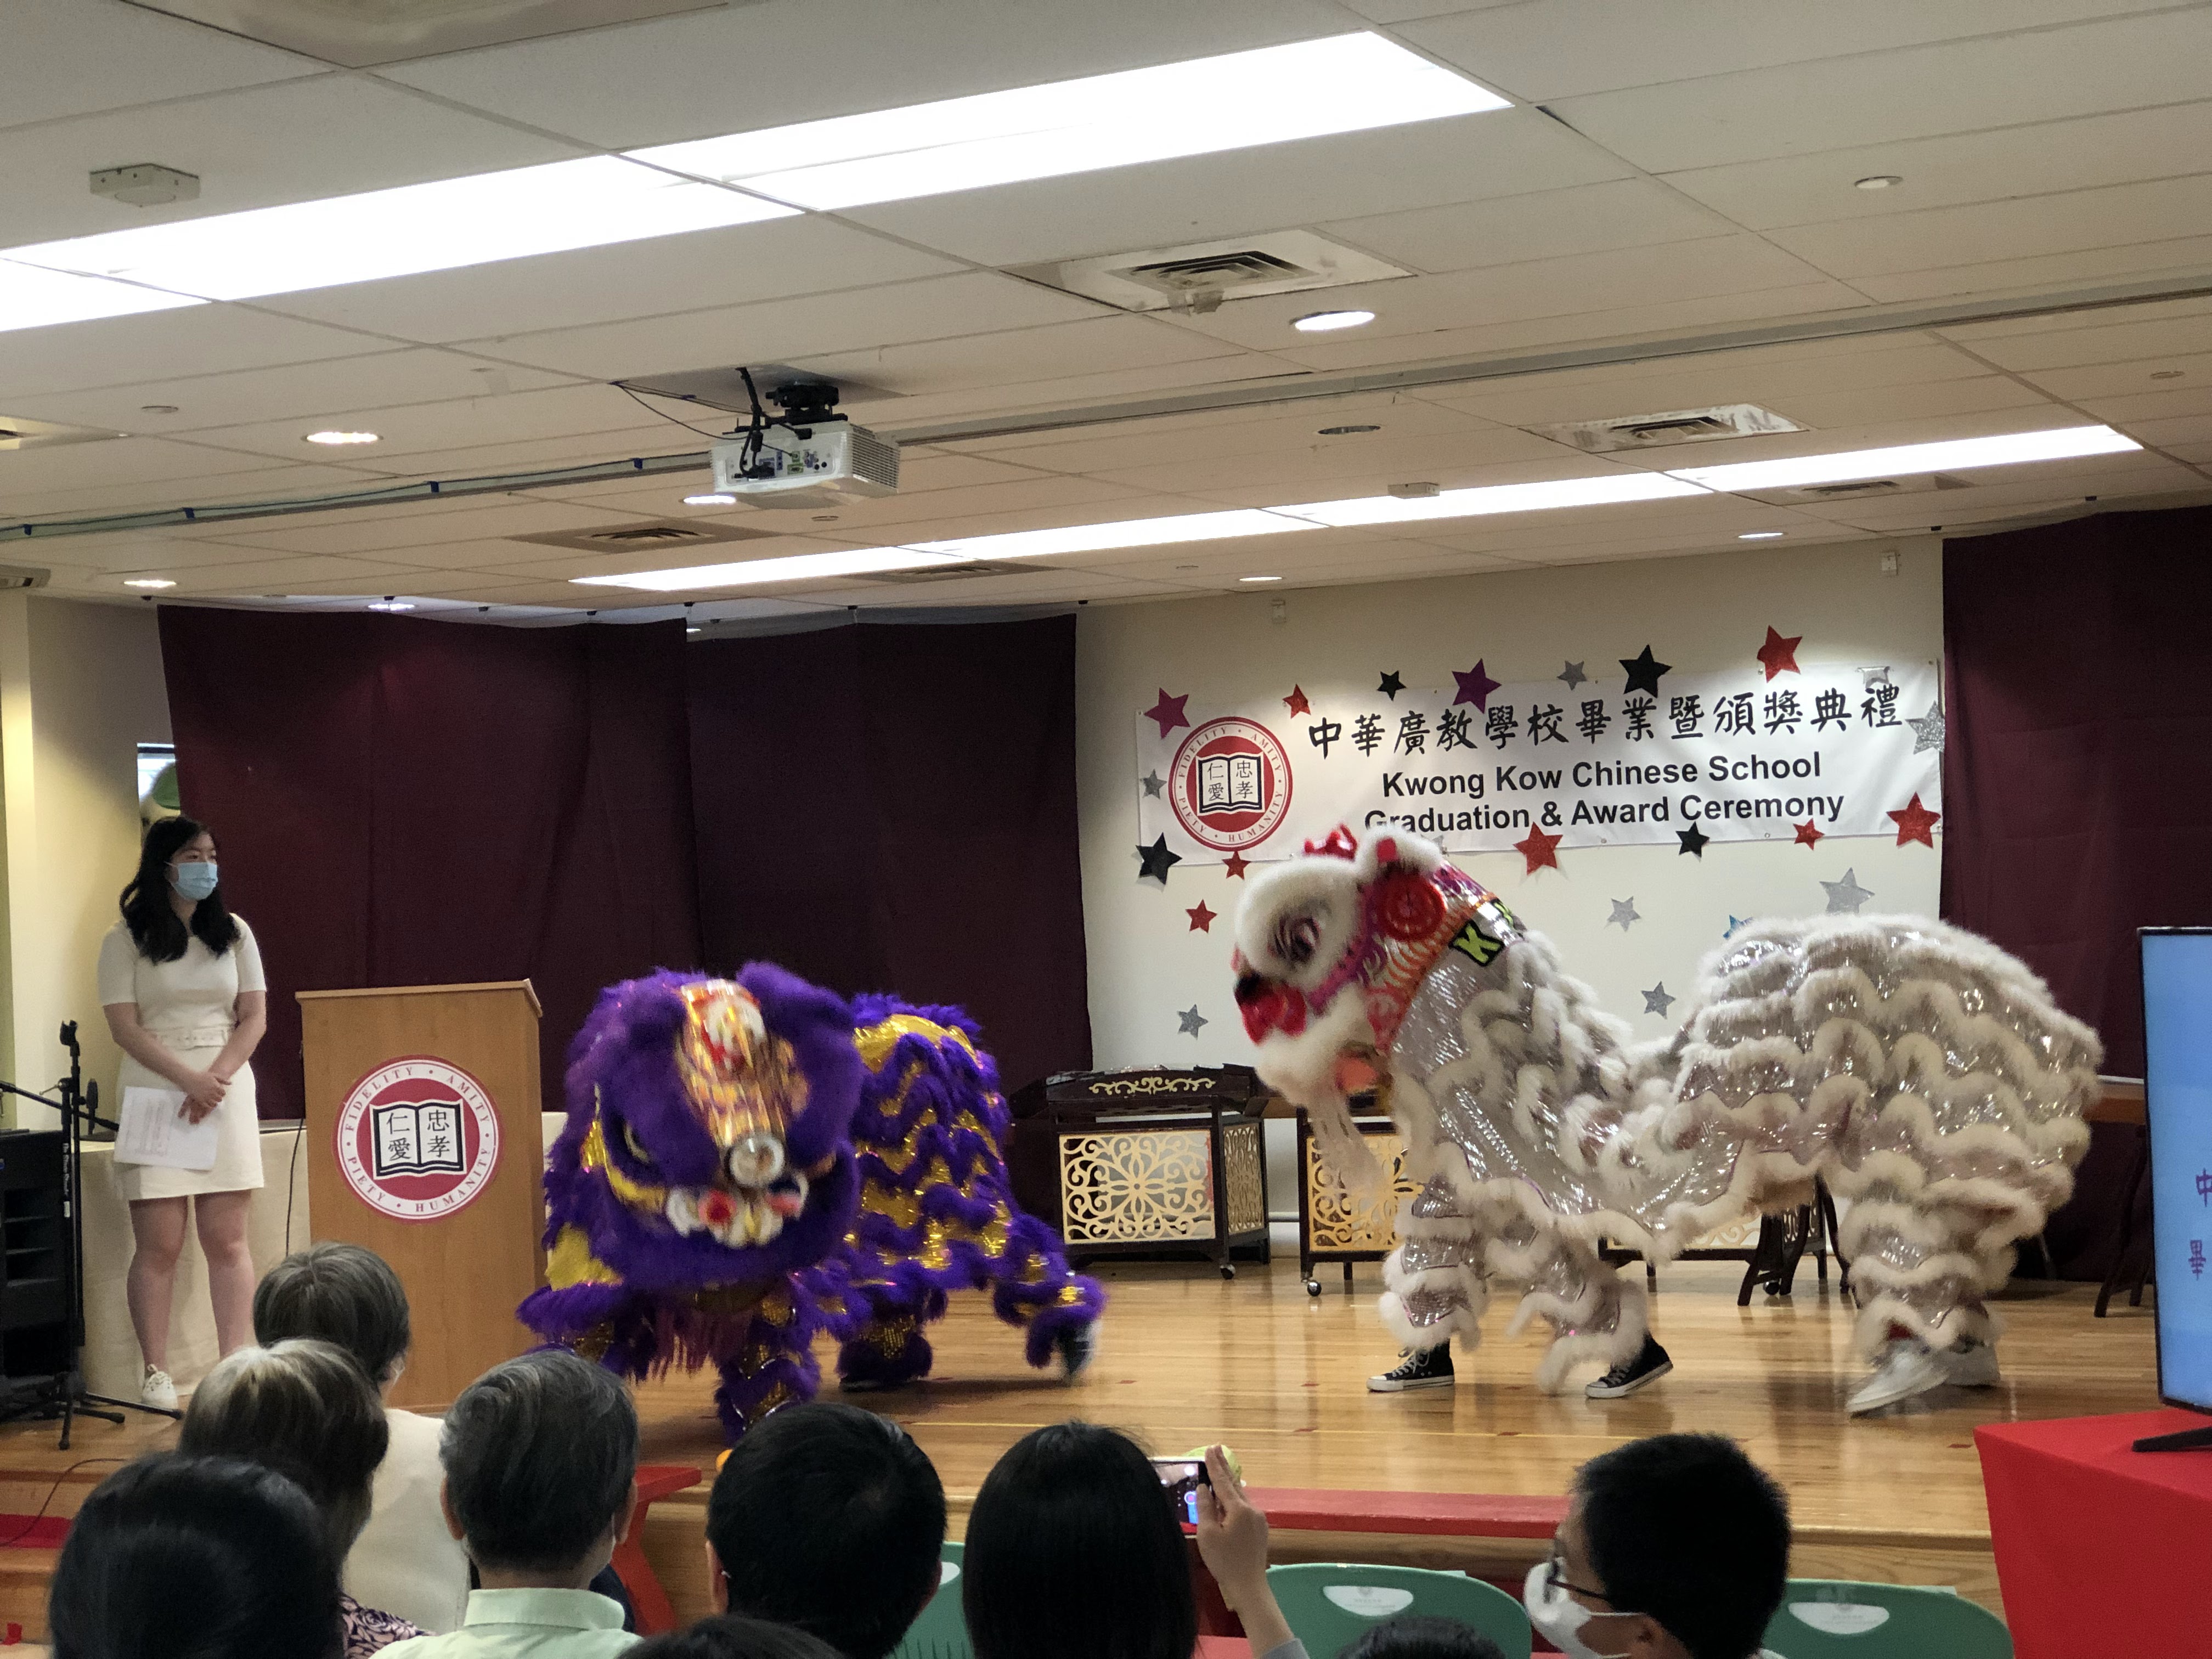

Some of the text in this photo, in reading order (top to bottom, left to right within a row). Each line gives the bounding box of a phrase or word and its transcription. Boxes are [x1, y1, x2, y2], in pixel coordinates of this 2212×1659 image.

[1308, 684, 1903, 760] 中華廣教學校畢業暨頒獎典禮
[1178, 727, 1228, 778] FIDELITY
[1250, 733, 1282, 771] AMITY
[1383, 751, 1821, 799] Kwong Kow Chinese School
[1207, 763, 1225, 802] 仁愛
[1235, 760, 1254, 799] 忠孝
[1178, 797, 1207, 834] PIETY
[1228, 792, 1283, 843] HUMANITY
[1541, 800, 1563, 826] &
[1571, 795, 1669, 826] Award
[1680, 794, 1844, 823] Ceremony
[345, 1066, 414, 1131] FIDELITY
[446, 1074, 490, 1123] AMITY
[386, 1112, 411, 1161] 仁愛
[426, 1109, 450, 1159] 忠孝
[347, 1156, 386, 1202] PIETY
[415, 1148, 491, 1213] HUMANITY
